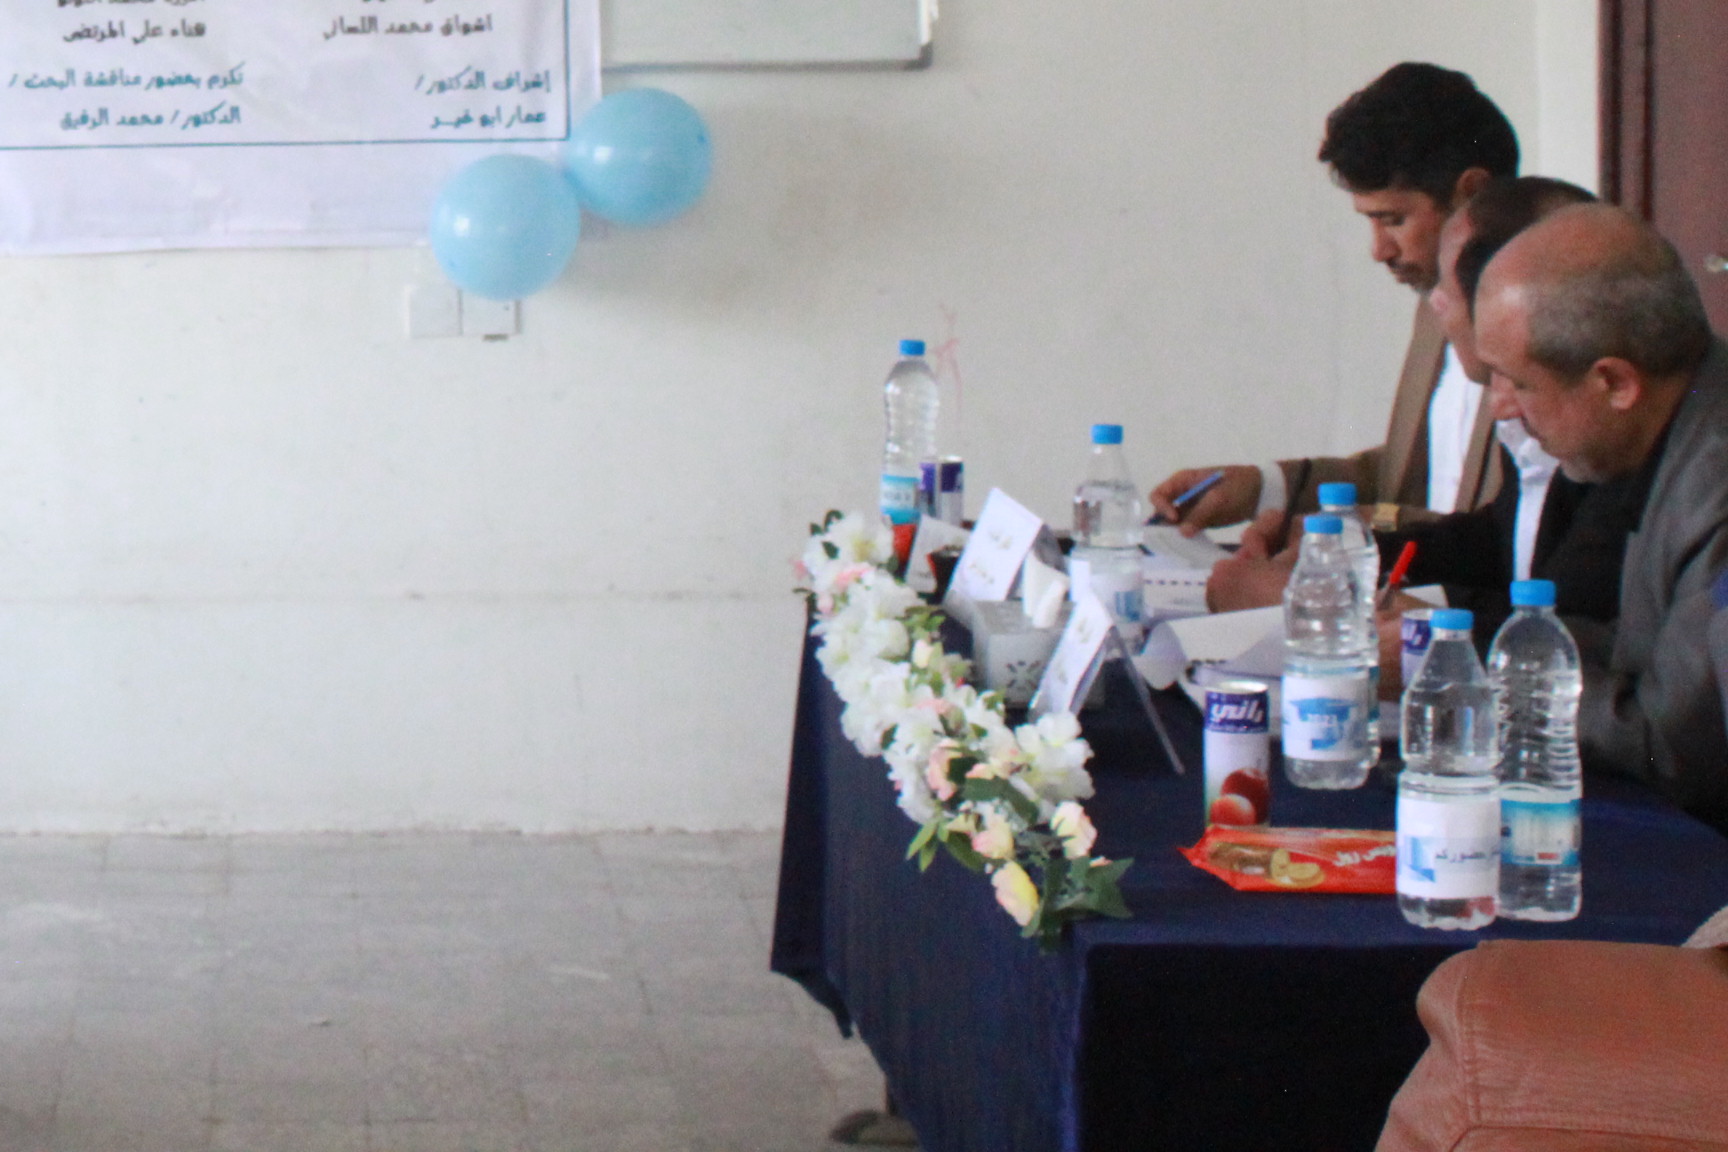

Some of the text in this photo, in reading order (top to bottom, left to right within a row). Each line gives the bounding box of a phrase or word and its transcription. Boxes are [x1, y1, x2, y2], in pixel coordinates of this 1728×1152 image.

[170, 18, 207, 38] هناء
[384, 20, 434, 35] محمد
[23, 67, 77, 91] البحث
[83, 68, 143, 88] مناقشة
[144, 72, 202, 91] بحضور
[207, 60, 246, 90] تكرم
[116, 112, 164, 127] محمد
[505, 104, 546, 129] عمار
[1209, 699, 1264, 724] راني
